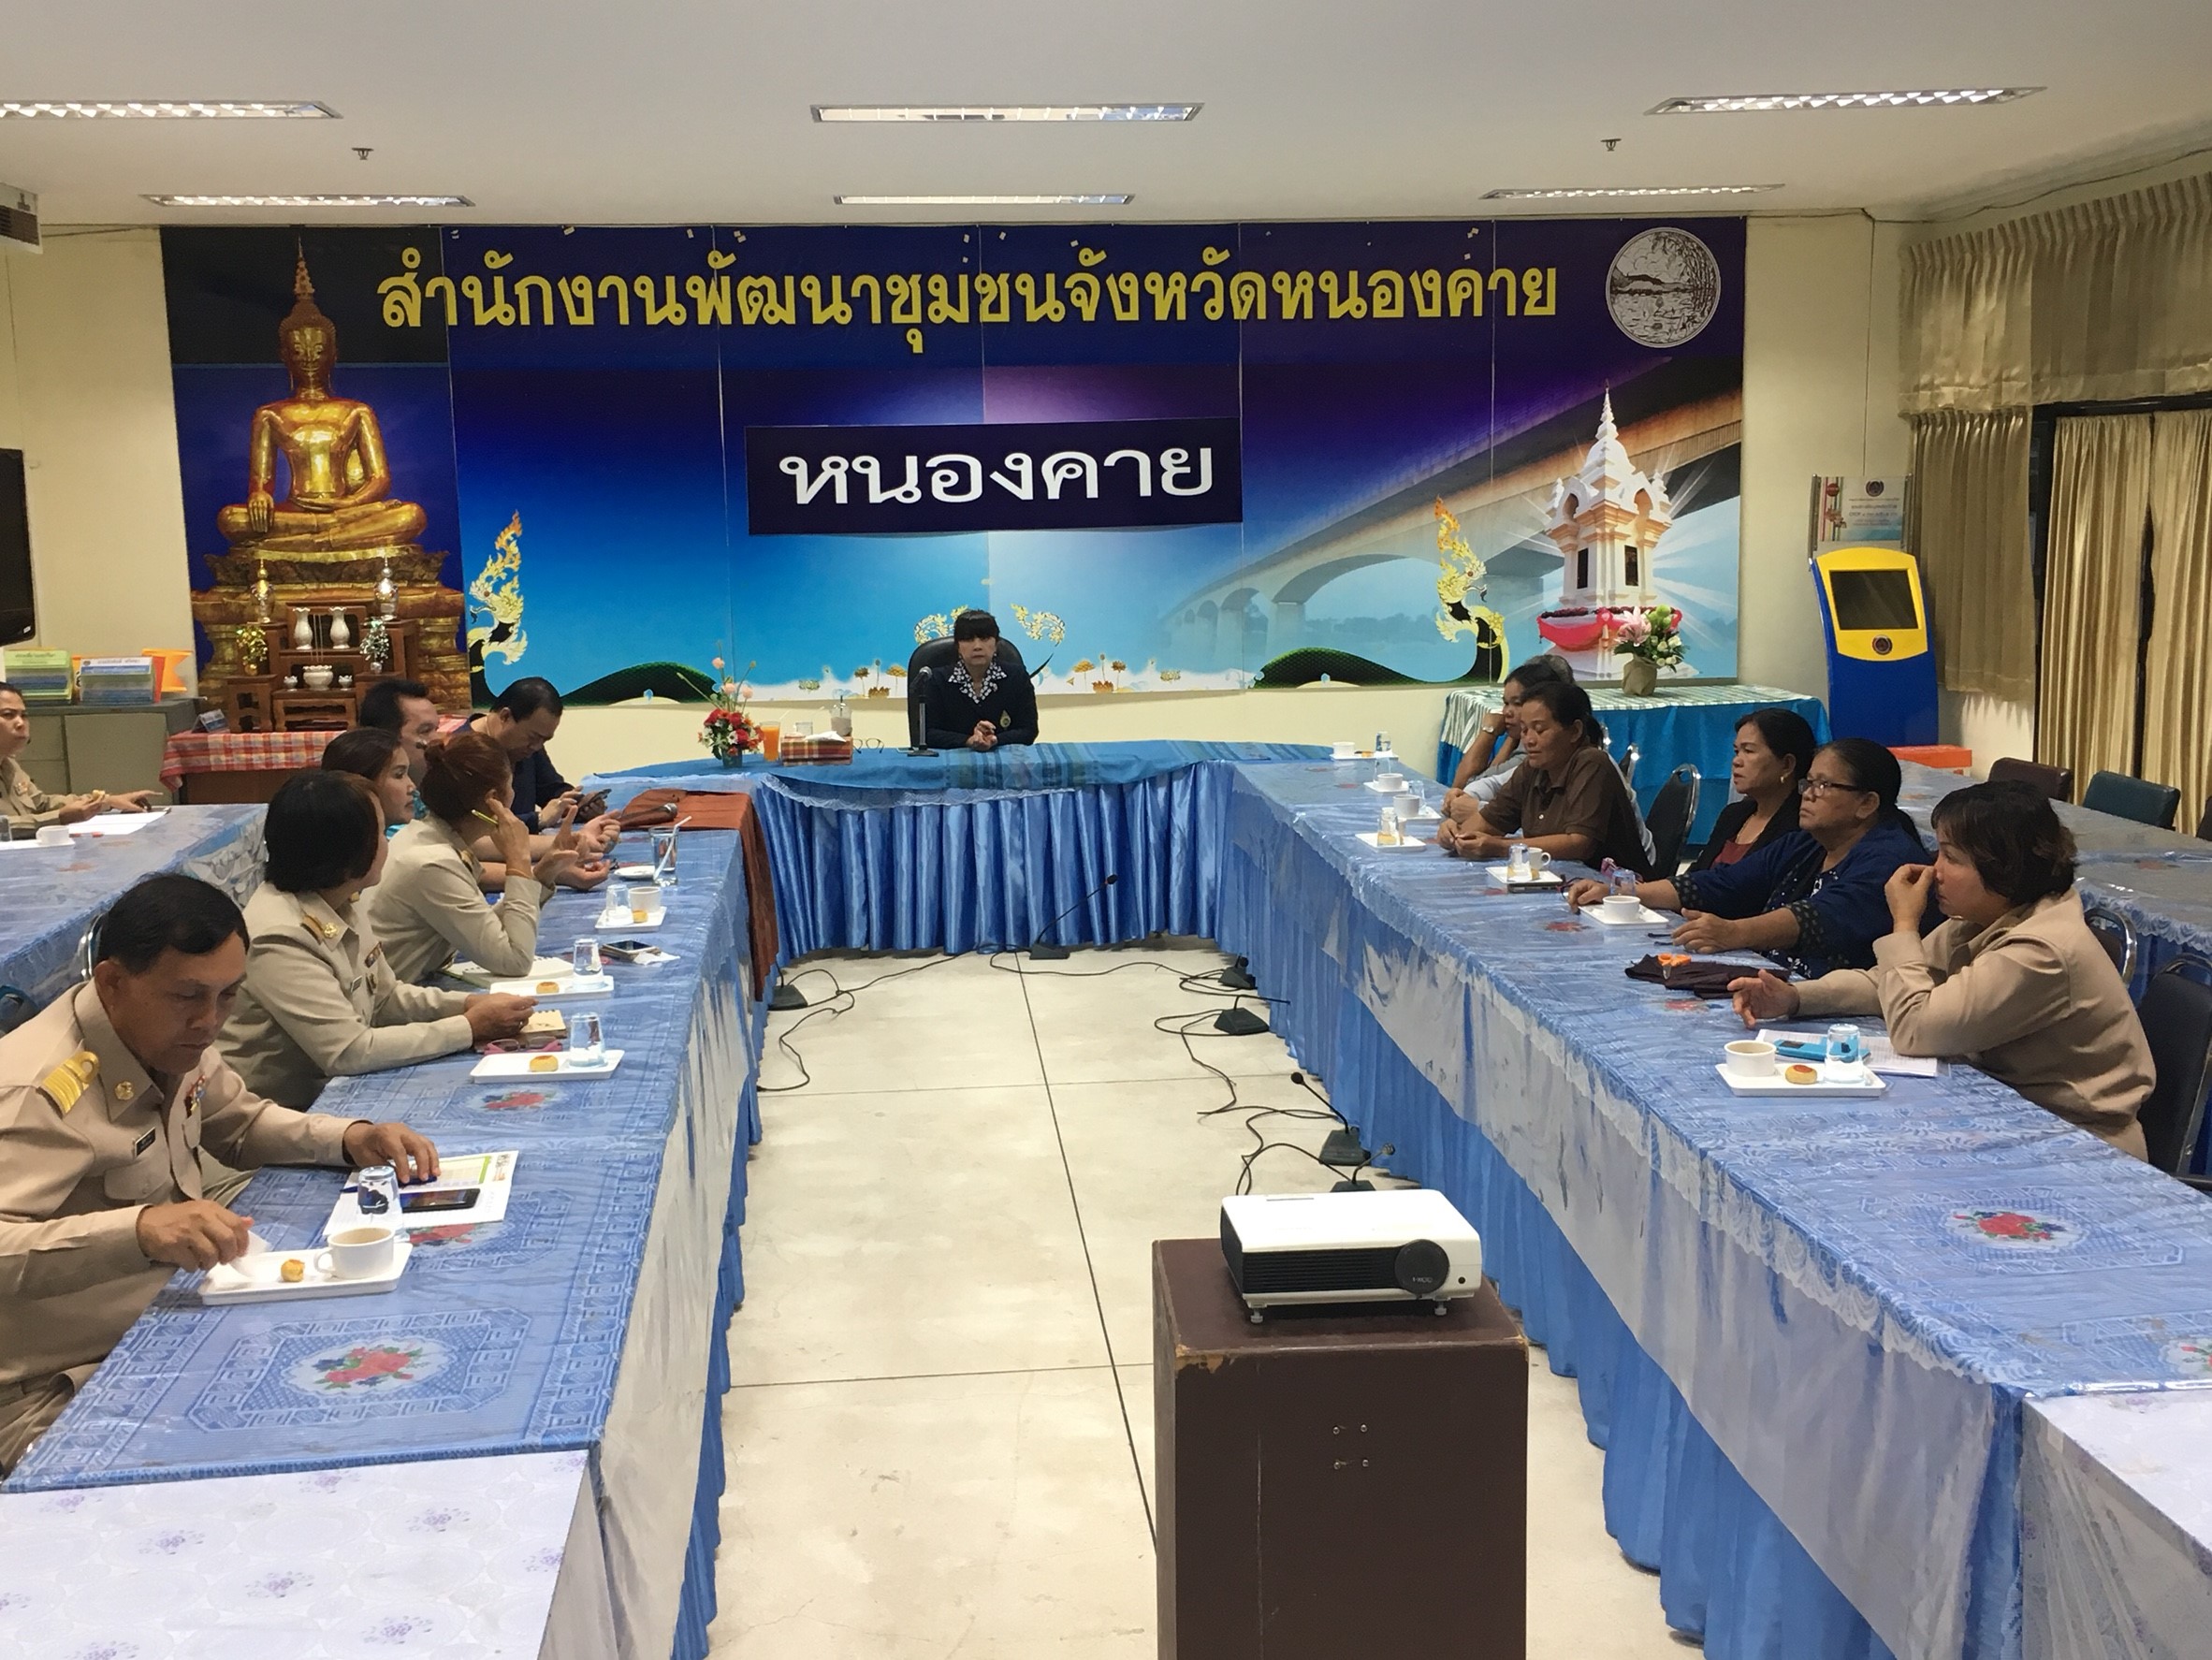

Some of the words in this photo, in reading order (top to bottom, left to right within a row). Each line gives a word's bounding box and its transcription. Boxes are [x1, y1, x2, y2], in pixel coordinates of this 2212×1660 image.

[377, 247, 1557, 353] สำนักงานพัฒนาชุมชนจังหวัดหนองคาย
[778, 447, 1214, 505] หนองคาย
